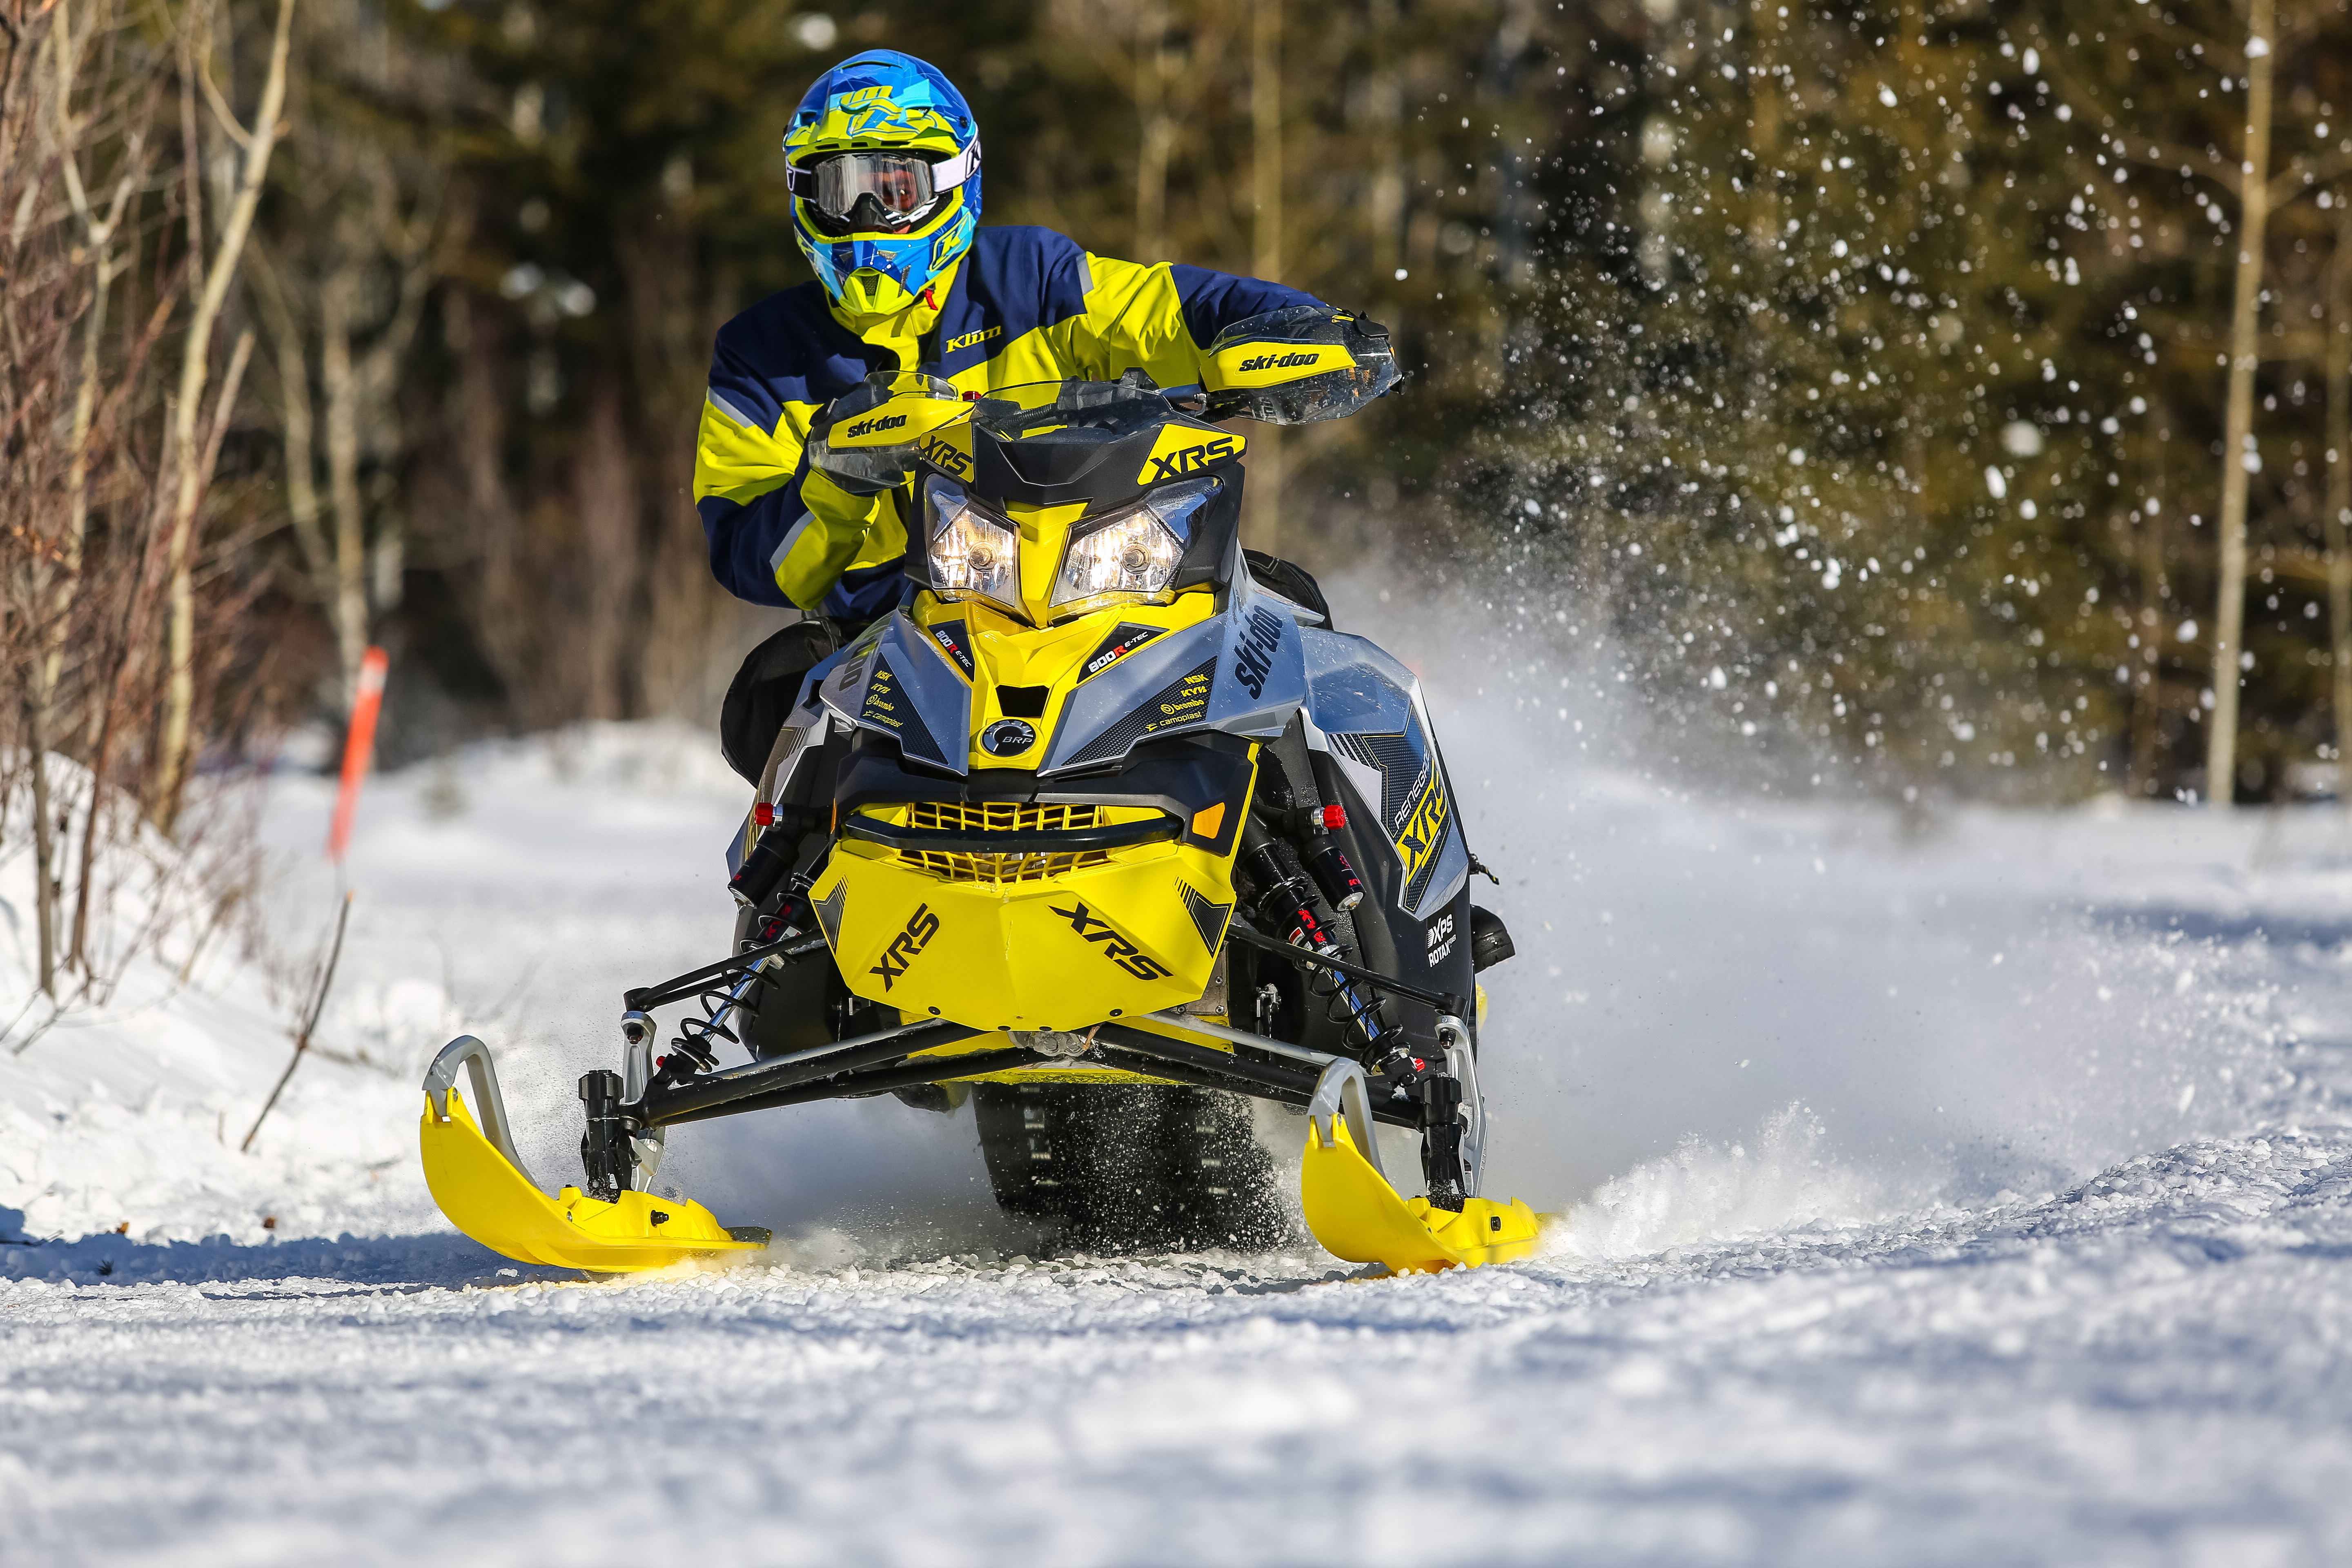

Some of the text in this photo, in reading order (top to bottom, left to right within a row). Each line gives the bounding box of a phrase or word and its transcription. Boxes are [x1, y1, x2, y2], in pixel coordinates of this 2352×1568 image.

[1238, 352, 1319, 372] ski-doo
[847, 414, 907, 439] ski-doo
[921, 434, 973, 477] XRS
[1149, 437, 1234, 481] XRS
[935, 630, 972, 667] 800R E-TEC
[1088, 631, 1148, 673] 800R E-TEC
[1234, 605, 1284, 701] ski-doo
[875, 670, 893, 681] NSK
[1184, 674, 1209, 684] NSK
[871, 683, 891, 694] KYB
[1180, 686, 1207, 697] KYB
[874, 697, 894, 711] brembo
[1172, 699, 1205, 710] brembo
[872, 713, 904, 728] camoplast
[1159, 711, 1202, 726] camoplast
[1048, 901, 1174, 980] XRS
[1433, 914, 1452, 942] XPS
[869, 902, 940, 992] XRS
[1428, 940, 1450, 968] ROTAX
